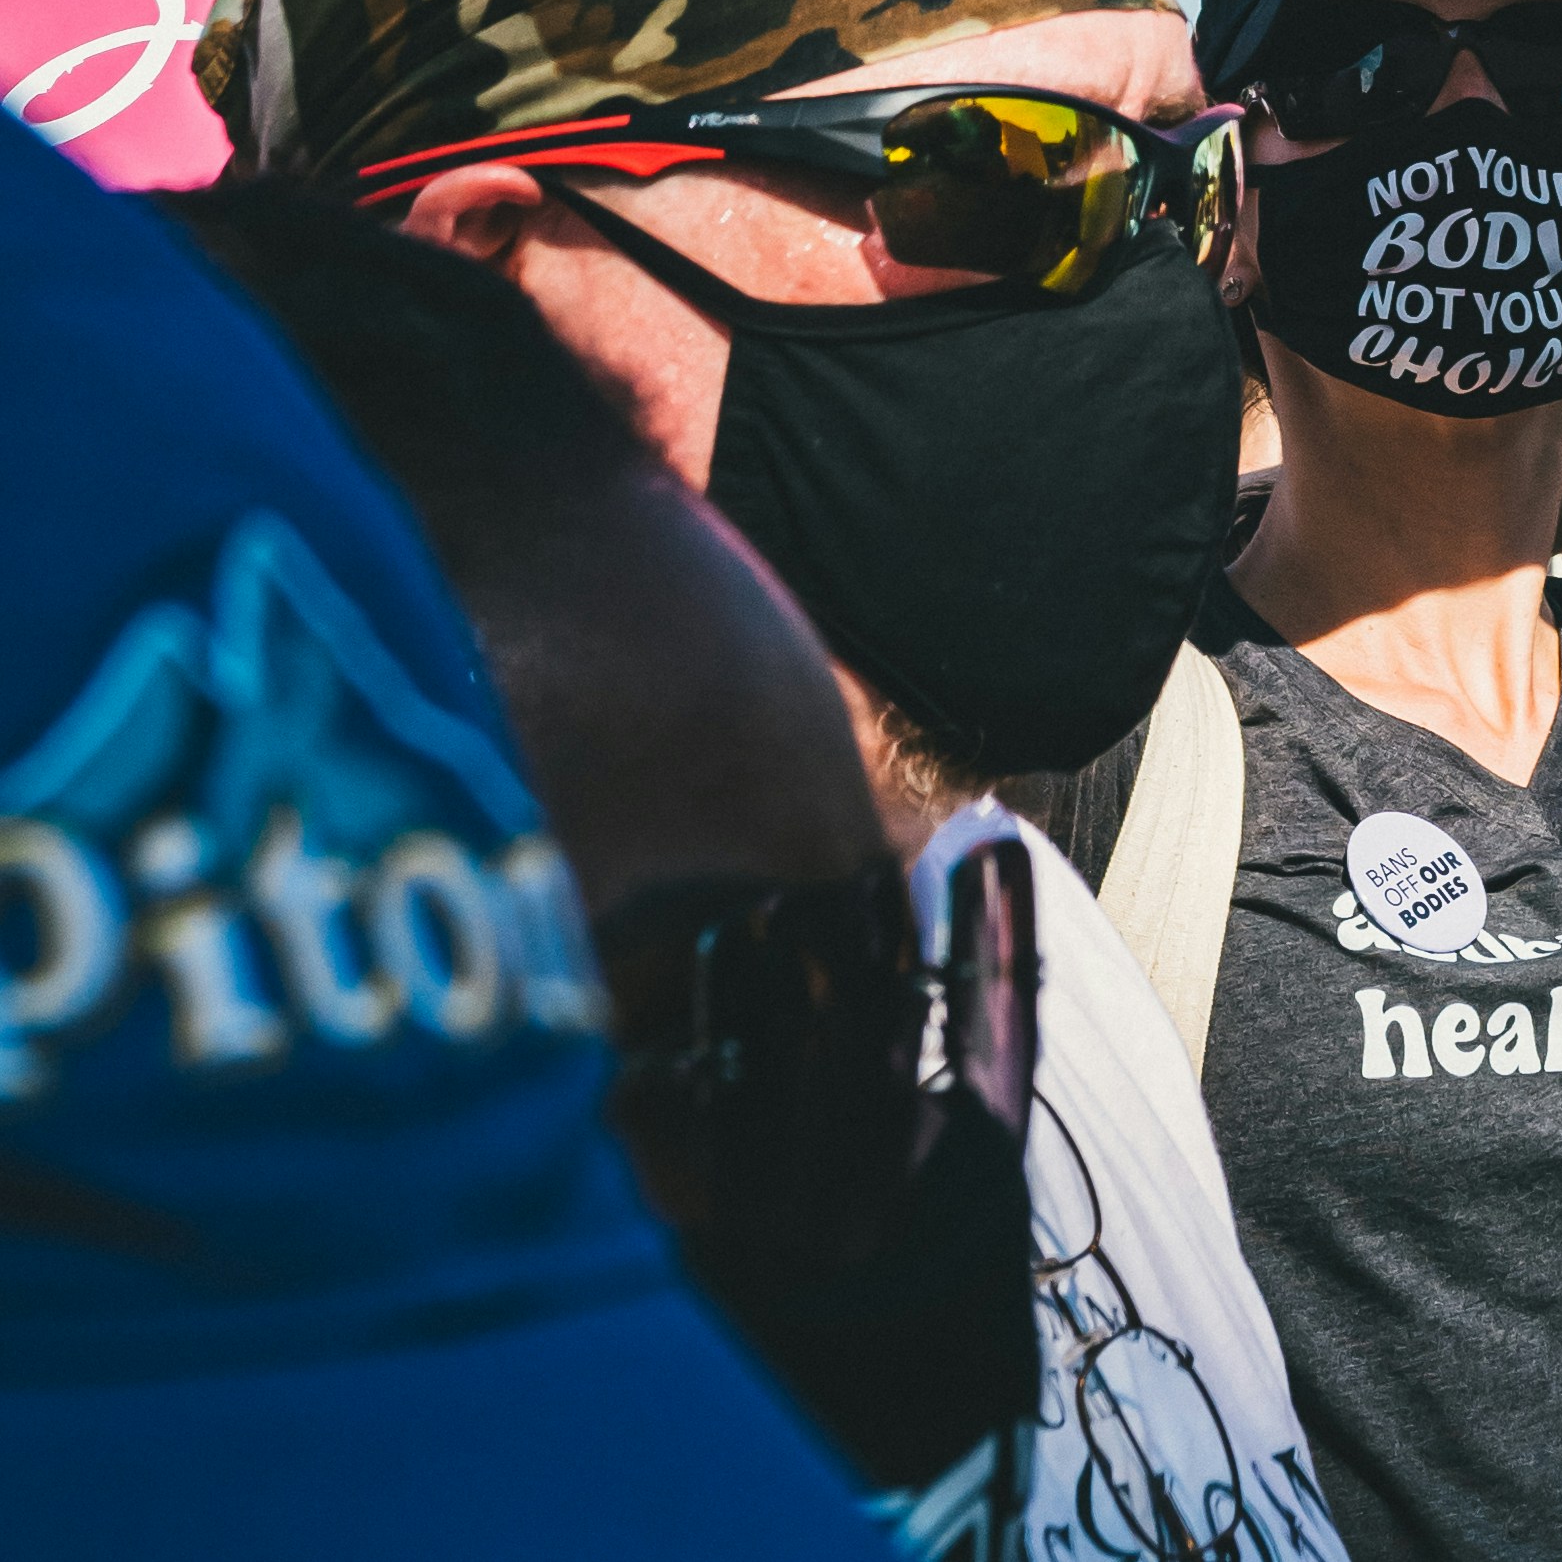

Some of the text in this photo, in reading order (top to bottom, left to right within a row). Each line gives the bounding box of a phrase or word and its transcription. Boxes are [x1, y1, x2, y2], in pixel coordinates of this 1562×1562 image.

[1367, 149, 1459, 217] NOT
[1358, 280, 1466, 330] NOT
[1365, 847, 1418, 888] BANS
[1384, 851, 1463, 907] OFF OUR
[1398, 876, 1469, 929] BODIES
